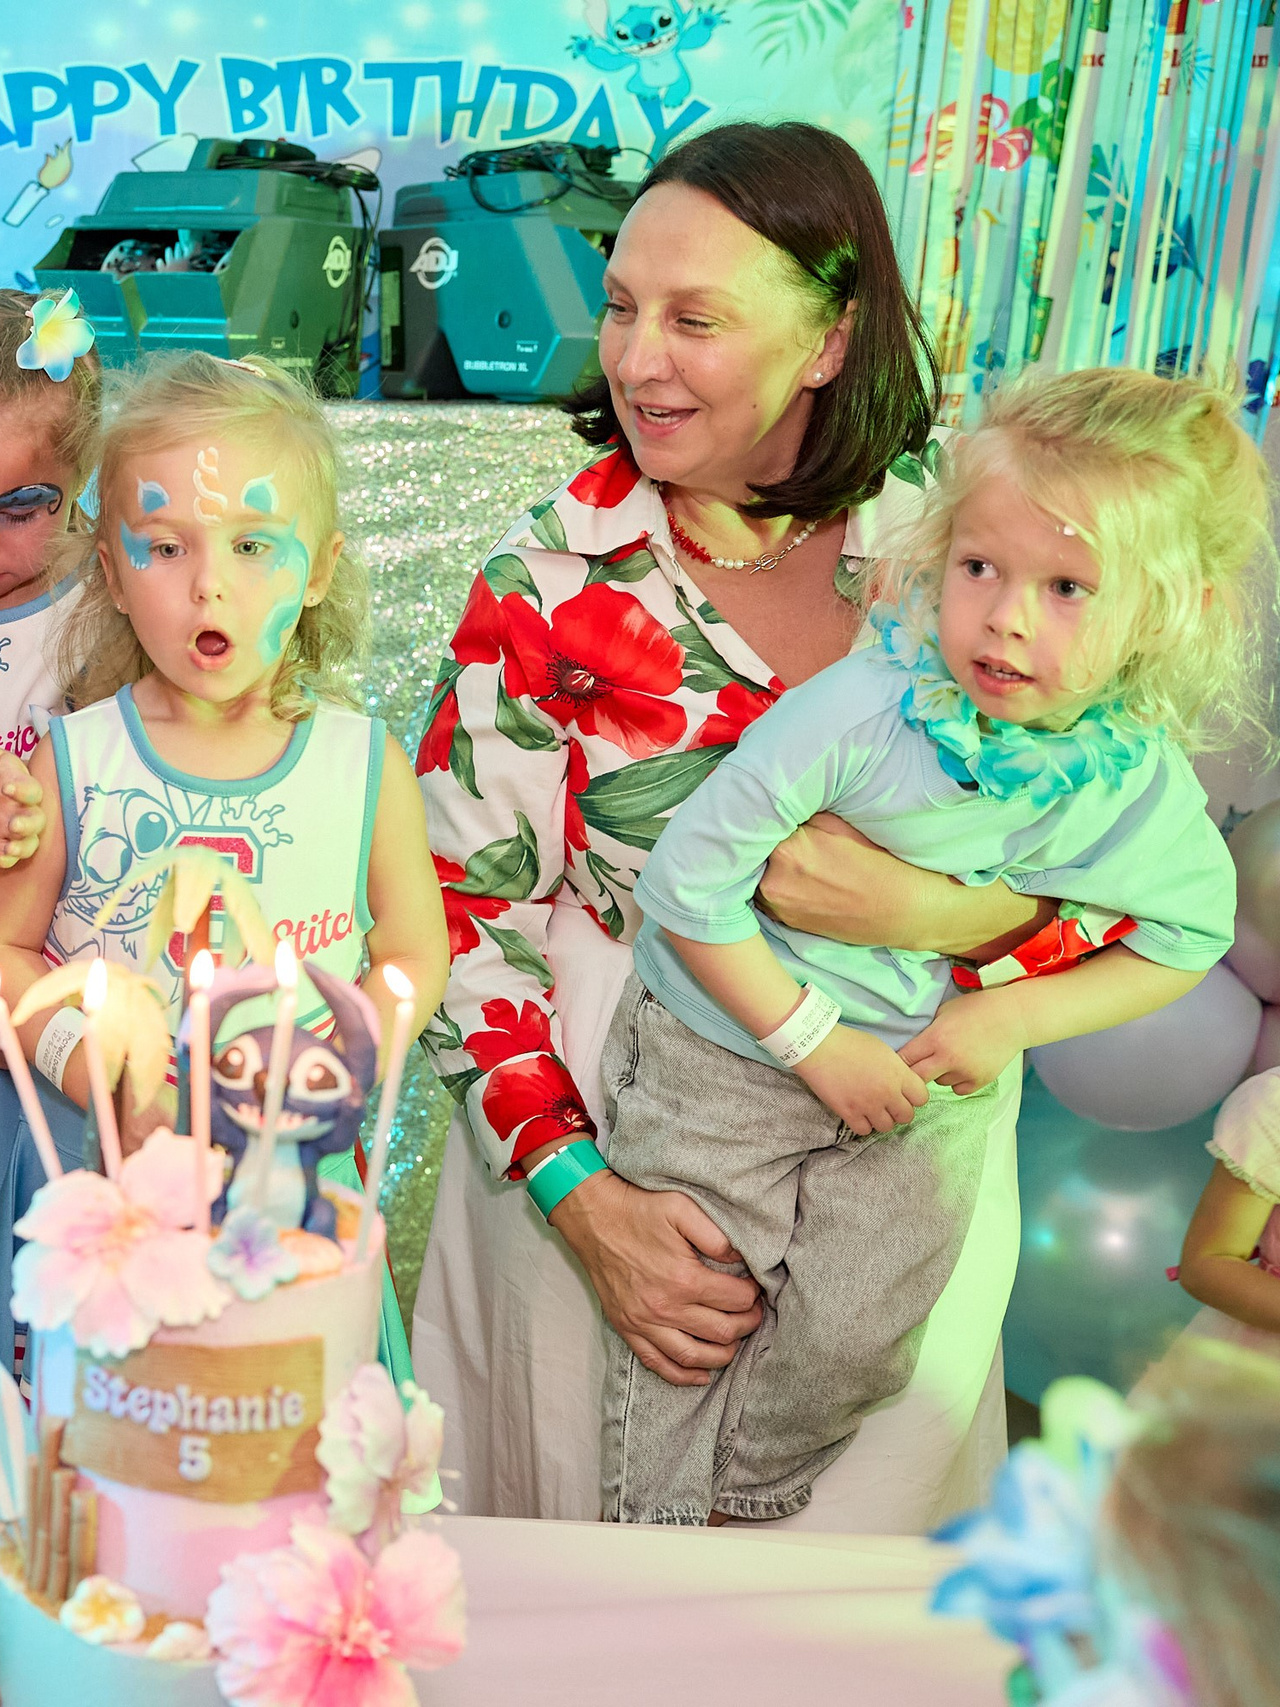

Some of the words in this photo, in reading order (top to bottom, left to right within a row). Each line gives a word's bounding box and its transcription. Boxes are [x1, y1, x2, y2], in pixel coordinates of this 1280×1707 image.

[217, 54, 712, 162] BIRTHDAY
[408, 249, 459, 273] ADJ
[463, 359, 516, 372] BUBBLETRON
[517, 360, 530, 373] XL
[272, 893, 356, 961] Stitc
[83, 1364, 307, 1434] Stephanie
[177, 1435, 214, 1482] 5
